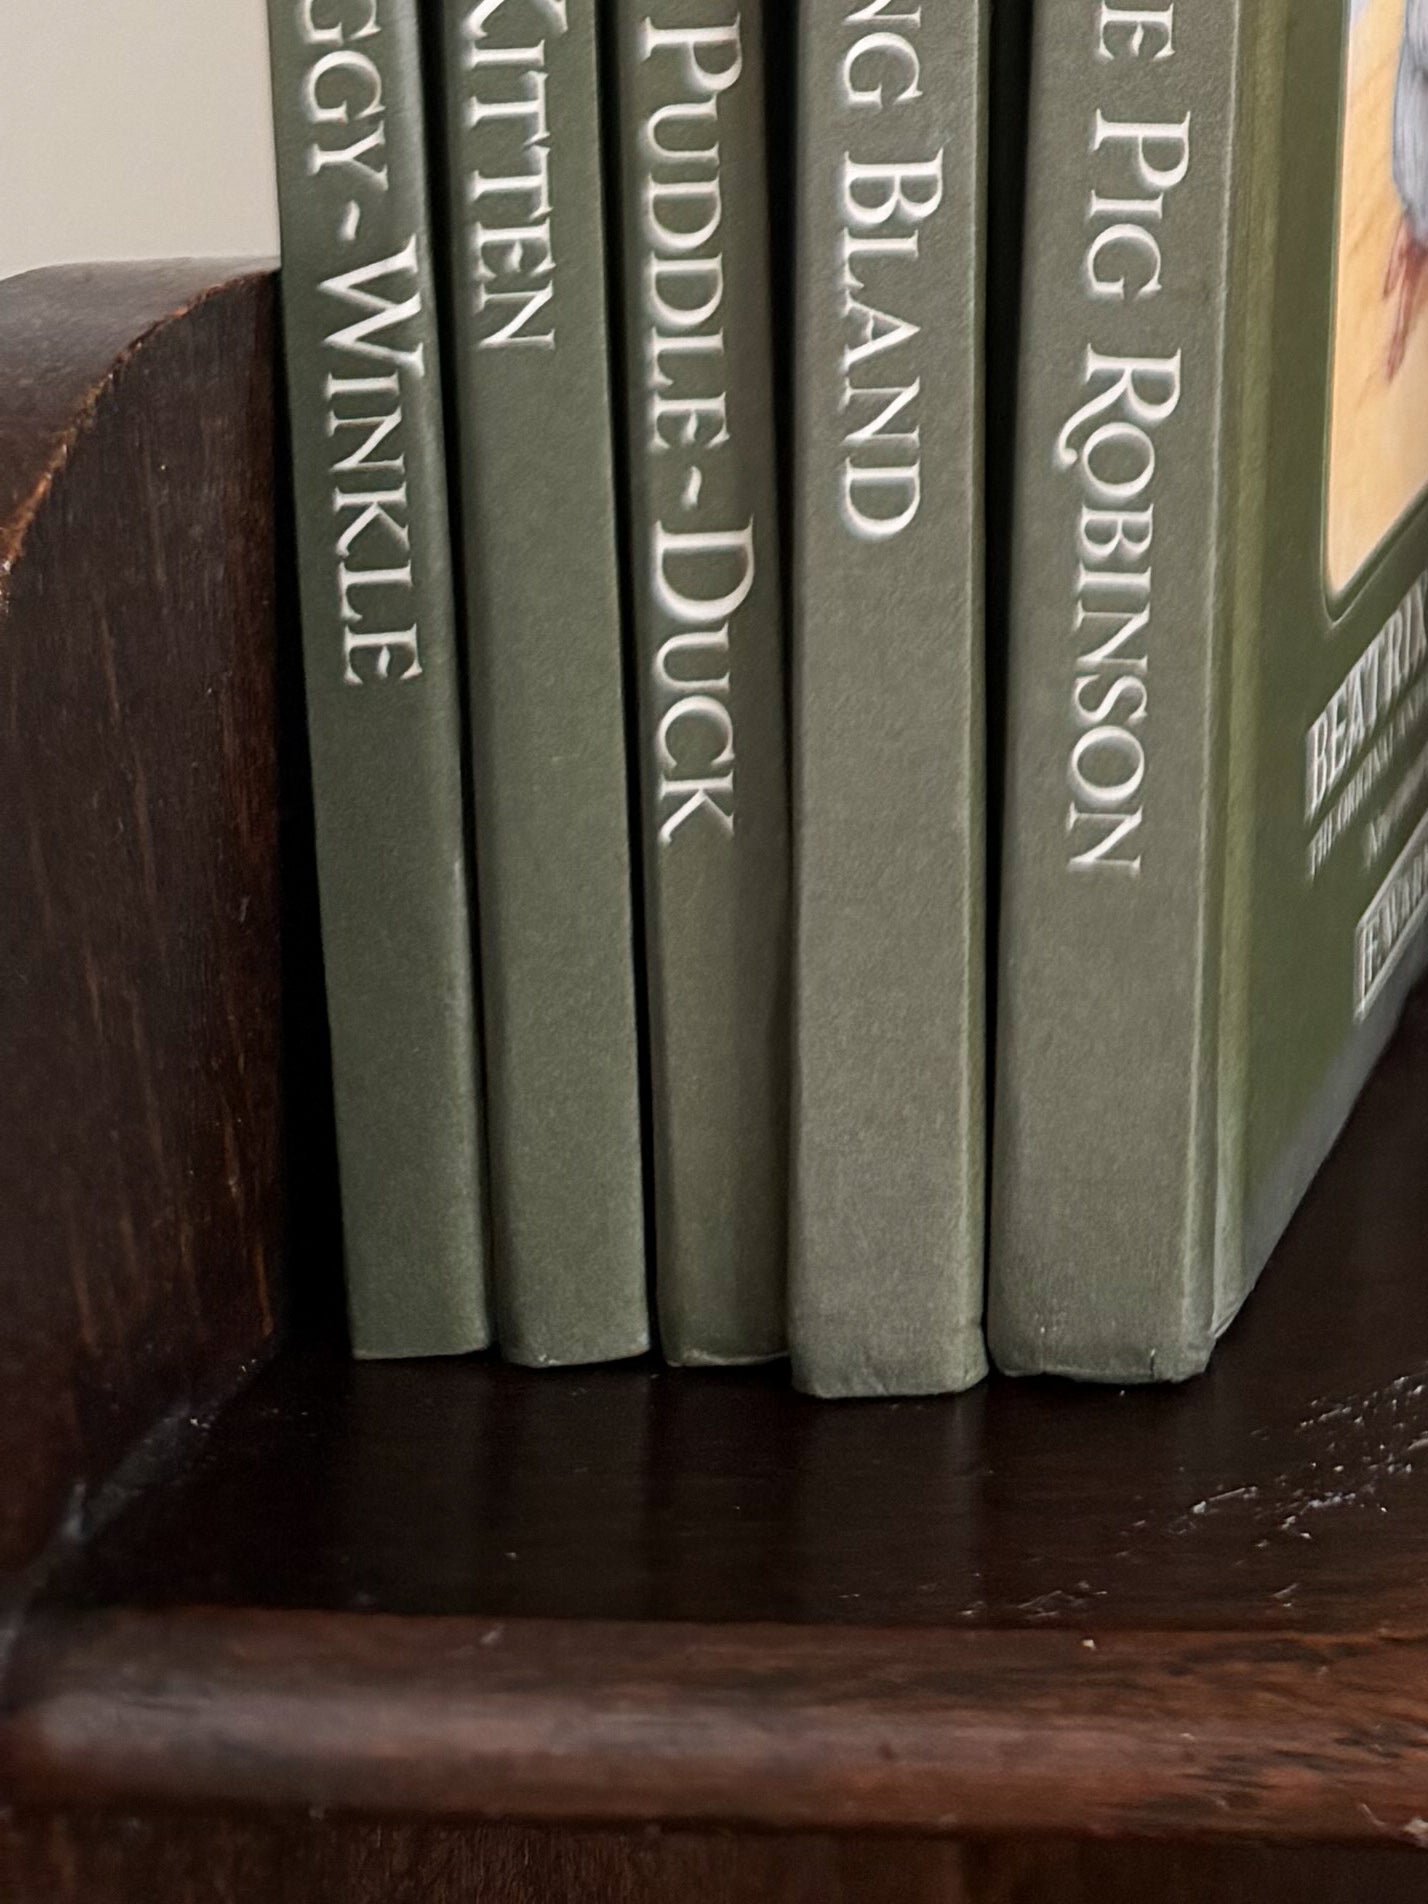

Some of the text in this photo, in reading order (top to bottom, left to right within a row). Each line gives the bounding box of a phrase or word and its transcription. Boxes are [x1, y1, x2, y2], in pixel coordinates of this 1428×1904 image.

[841, 148, 943, 538] BLAND
[1085, 109, 1191, 296] PIG
[1056, 344, 1181, 871] ROBINSON
